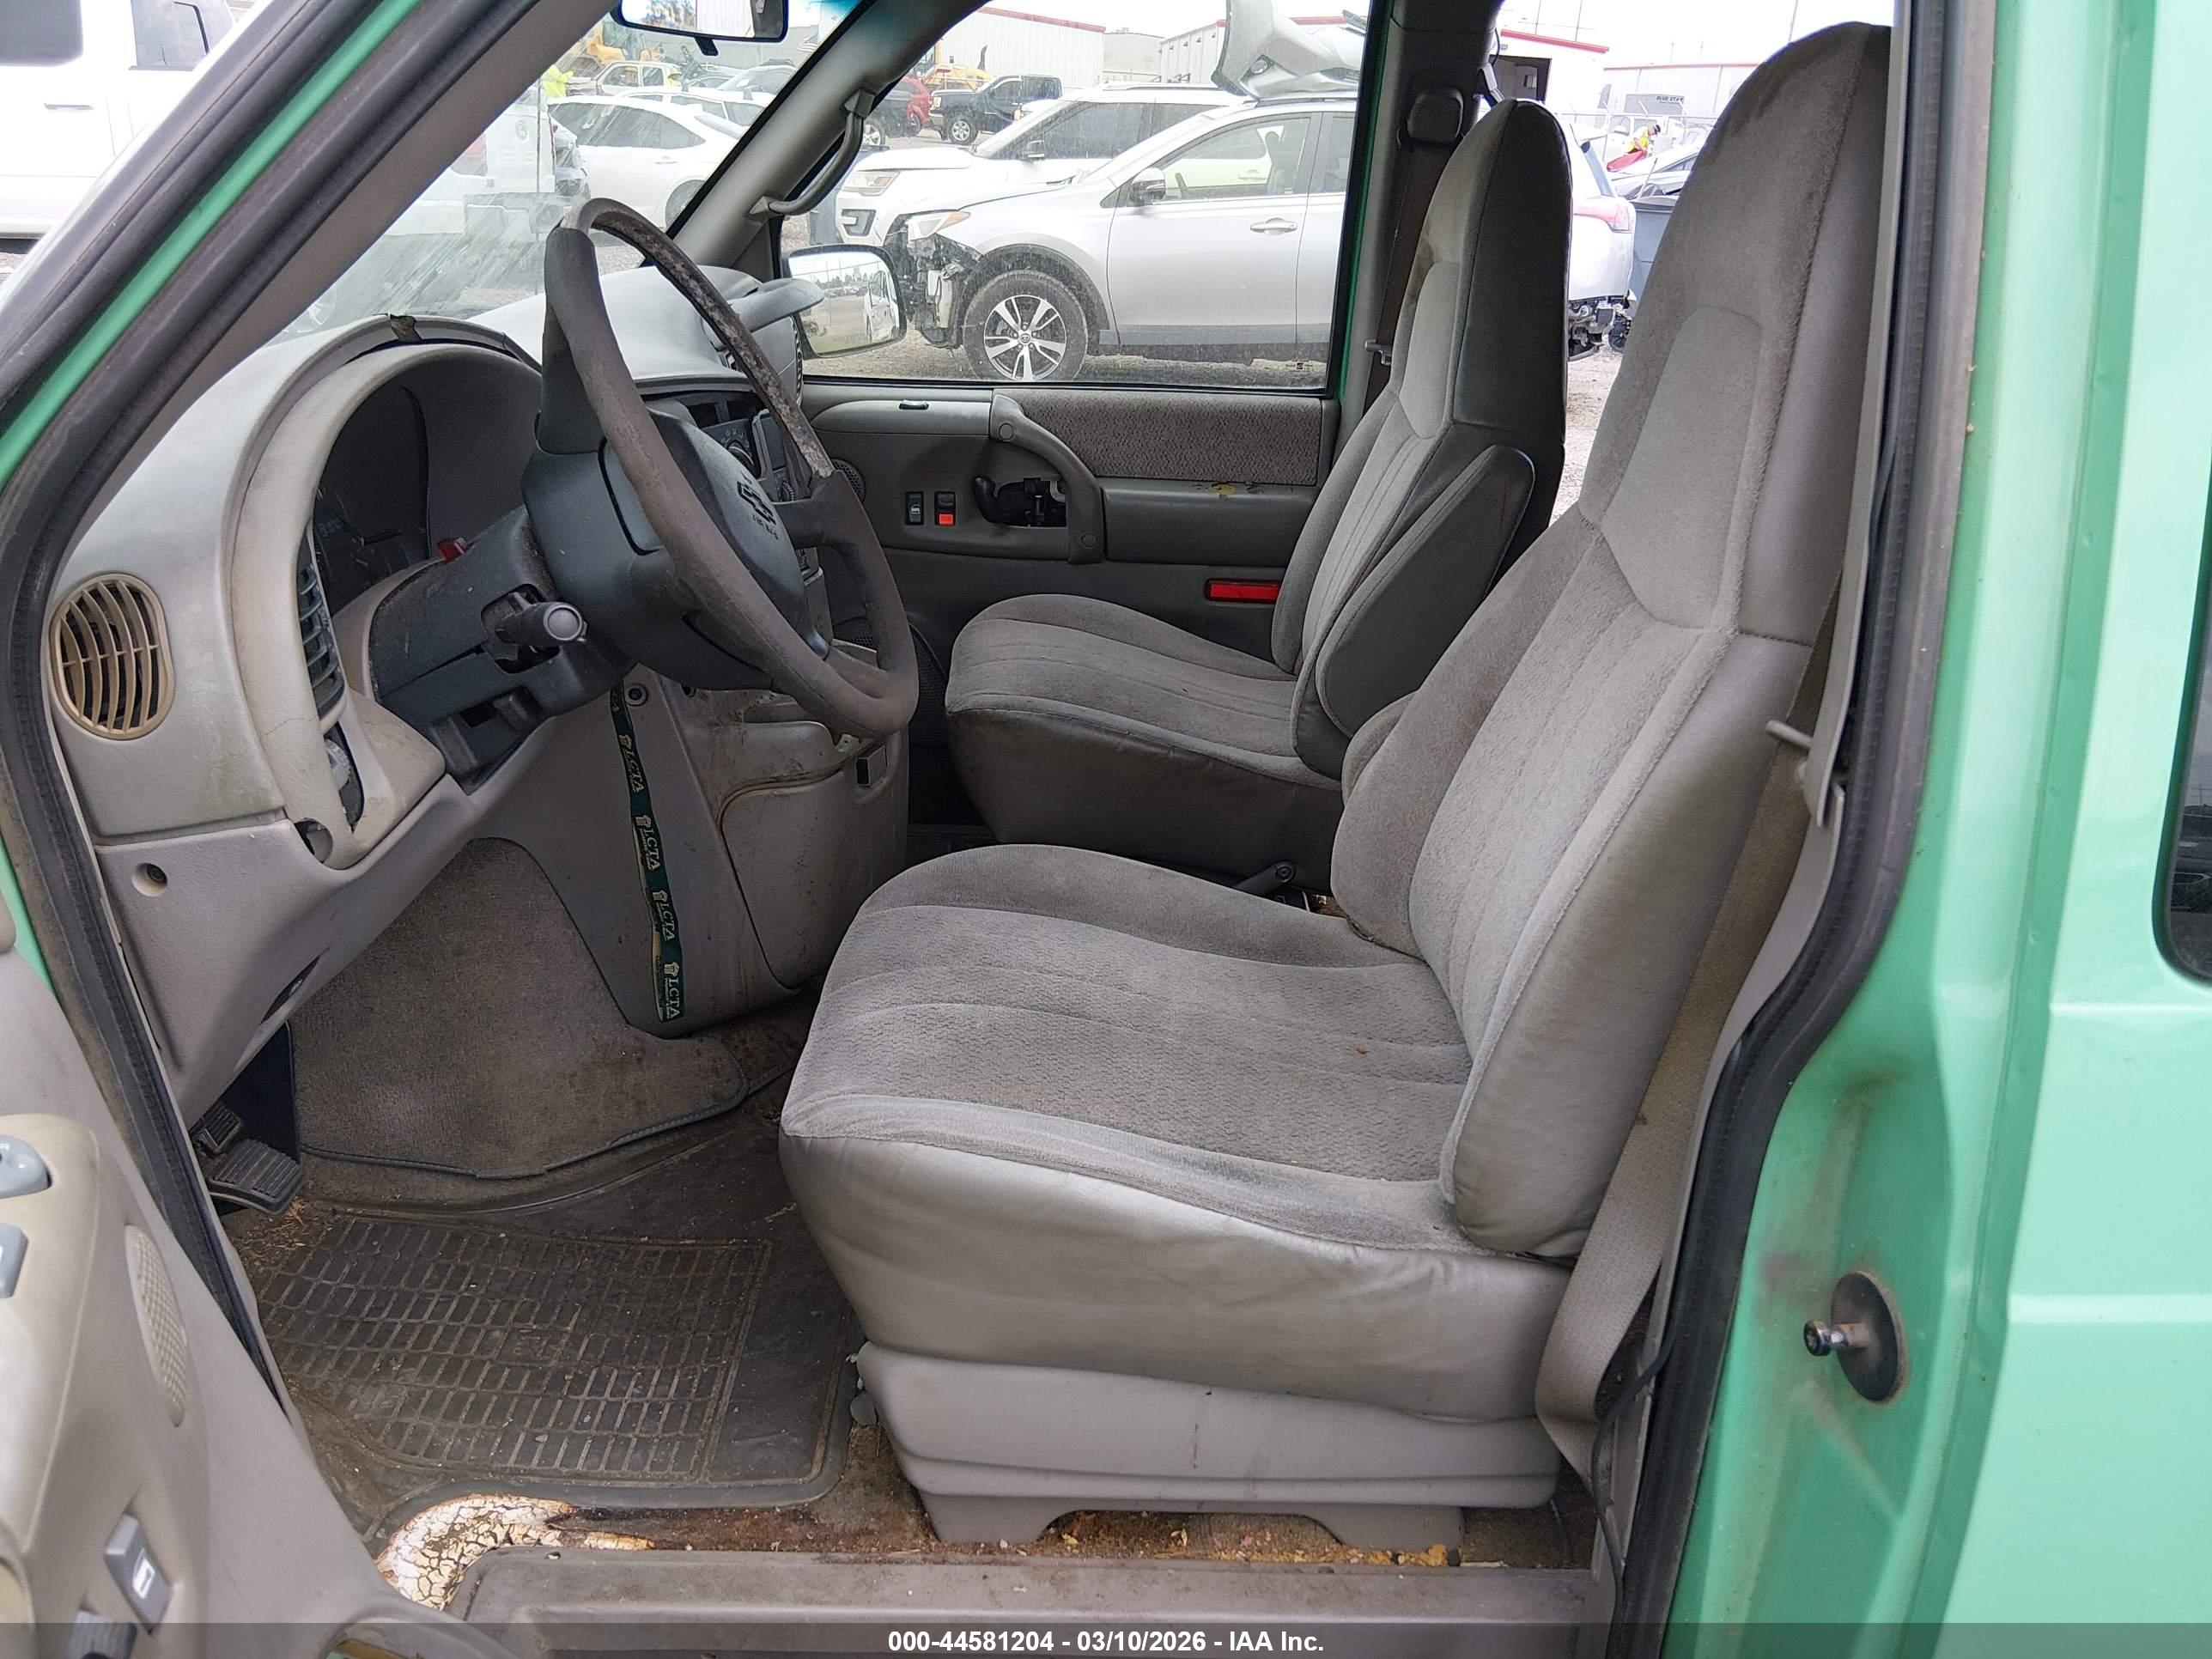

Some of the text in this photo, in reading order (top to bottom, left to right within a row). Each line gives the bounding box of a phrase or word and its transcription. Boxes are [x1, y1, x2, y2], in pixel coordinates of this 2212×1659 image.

[644, 829, 661, 871] LCTA
[660, 902, 675, 941] LCTA
[668, 977, 680, 1019] LCTA
